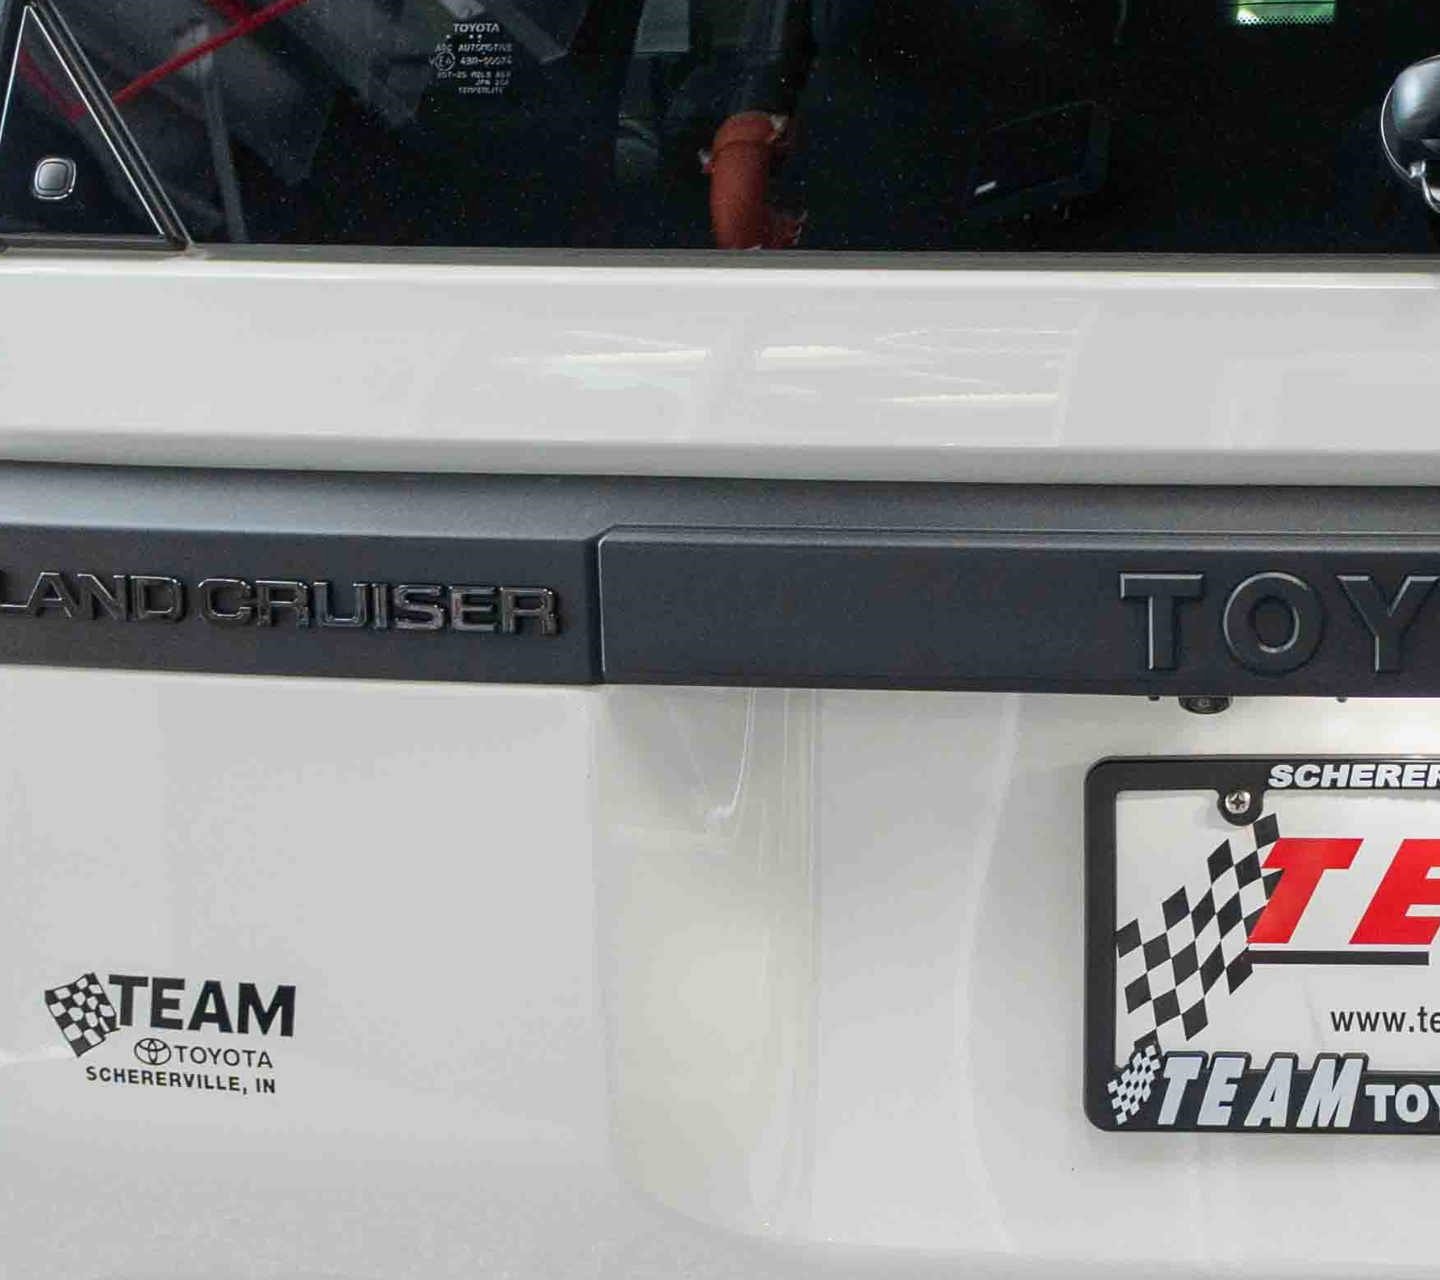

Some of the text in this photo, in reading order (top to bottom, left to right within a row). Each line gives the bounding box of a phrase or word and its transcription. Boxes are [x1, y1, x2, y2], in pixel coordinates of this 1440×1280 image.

[453, 23, 500, 33] TOYOTA
[197, 577, 561, 638] CRUISER
[108, 974, 297, 1038] TEAM
[174, 1044, 274, 1069] TOYOTA
[85, 1065, 276, 1095] SCHERERVILLE, IN
[1157, 1056, 1366, 1128] TEAM
